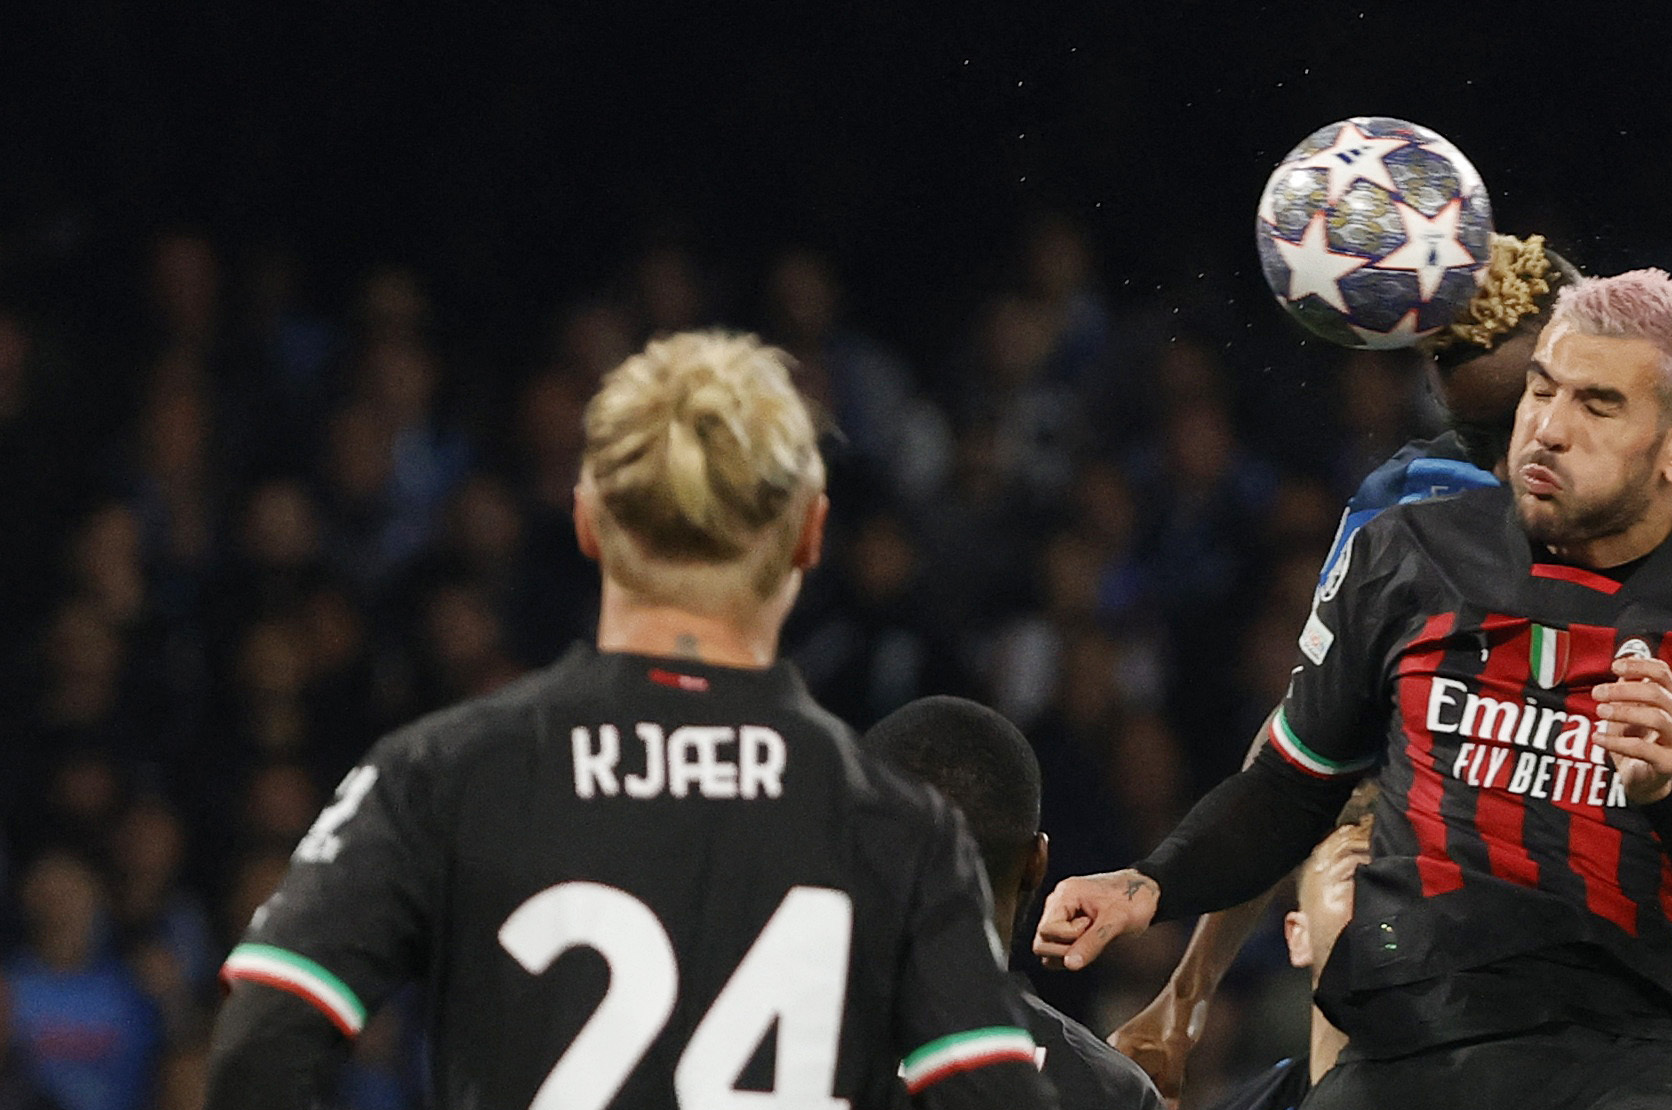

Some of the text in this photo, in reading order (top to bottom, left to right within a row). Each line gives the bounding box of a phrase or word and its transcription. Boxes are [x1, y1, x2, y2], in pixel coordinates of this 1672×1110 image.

[571, 721, 788, 800] KJÆR
[1453, 742, 1627, 808] FLY BETTER
